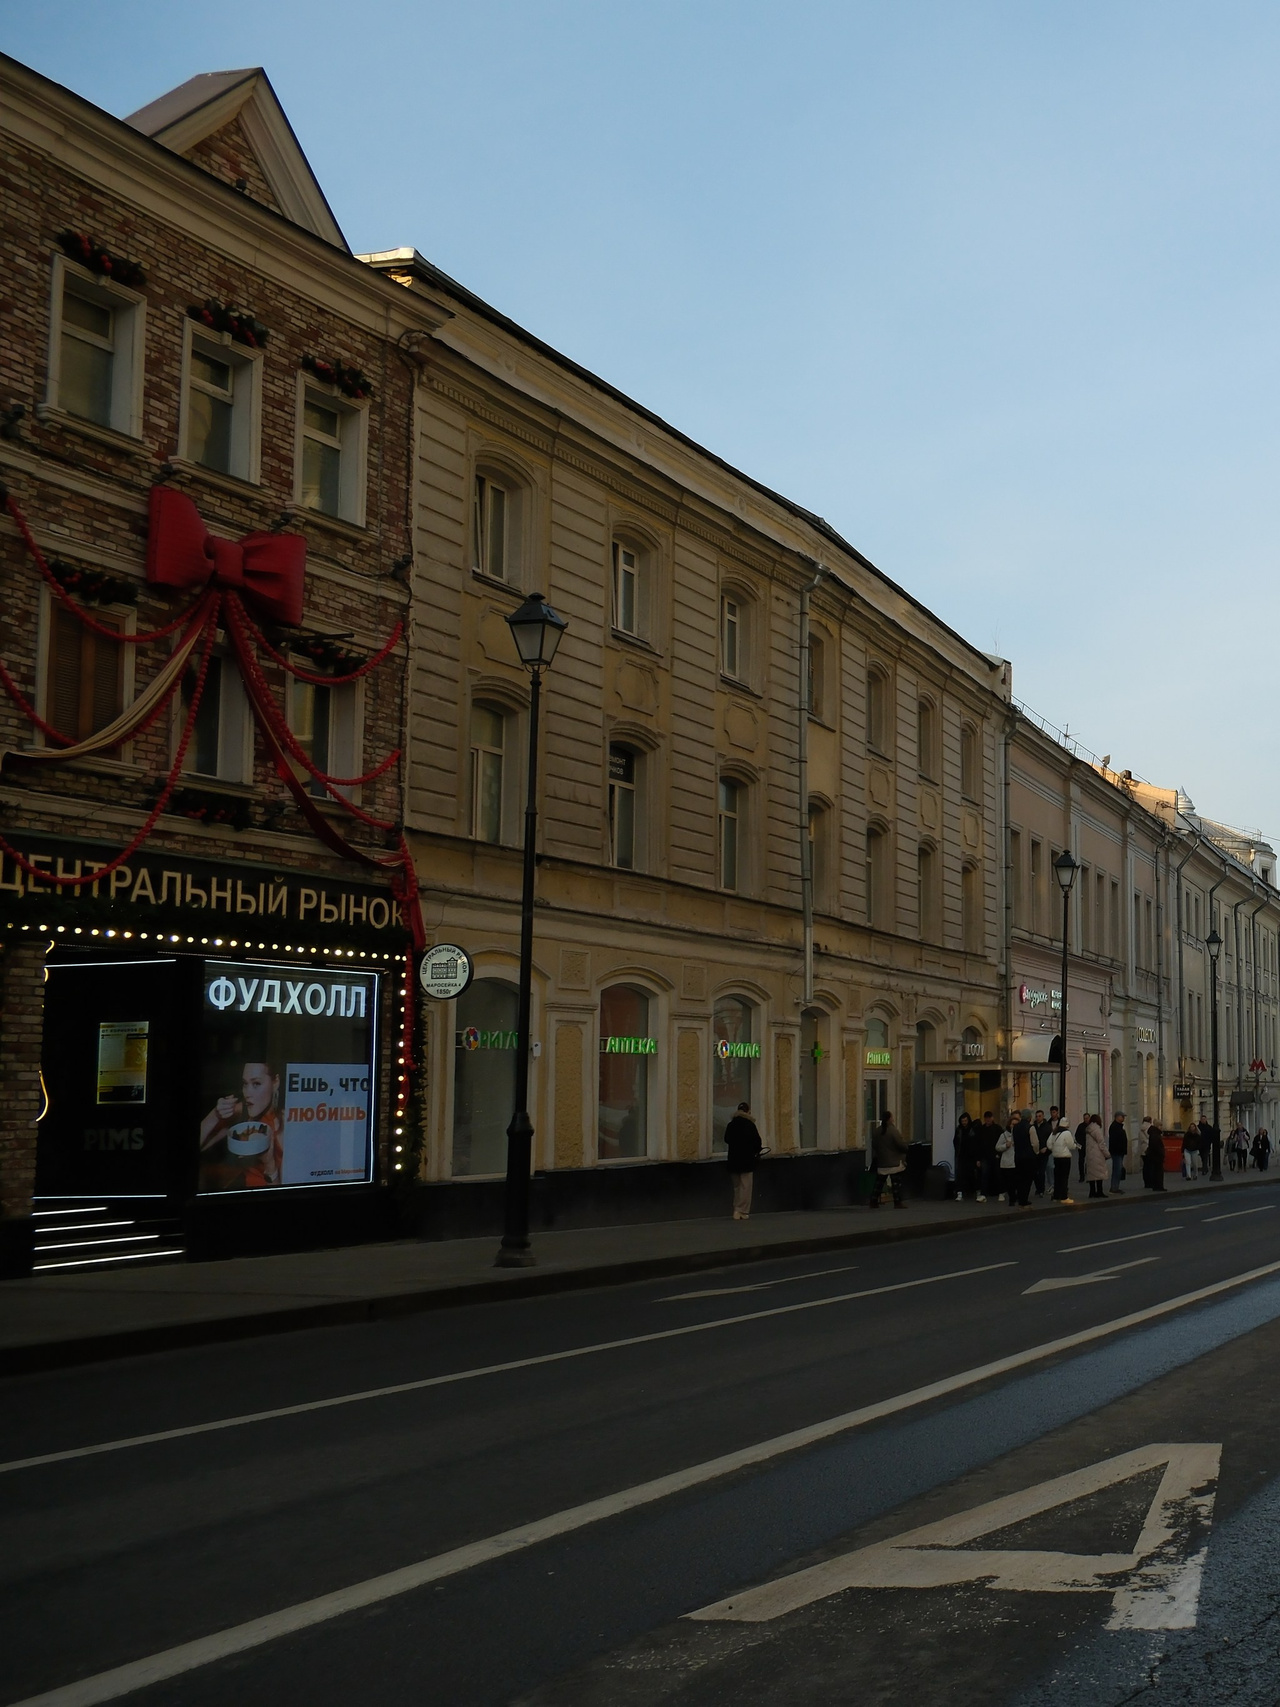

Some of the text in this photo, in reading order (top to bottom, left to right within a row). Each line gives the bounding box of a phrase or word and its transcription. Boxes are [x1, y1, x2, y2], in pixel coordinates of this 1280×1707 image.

[0, 850, 404, 930] ЦЕНТРАЛЬНЫЙ РЫНОК
[422, 947, 456, 975] ЦЕНТРАЛЬНЫЙ
[208, 976, 366, 1018] ФУДХОЛЛ
[605, 1037, 656, 1055] АПТЕКА
[288, 1073, 370, 1096] Ешь, что
[287, 1103, 366, 1122] любишь
[82, 1128, 145, 1151] PIMS
